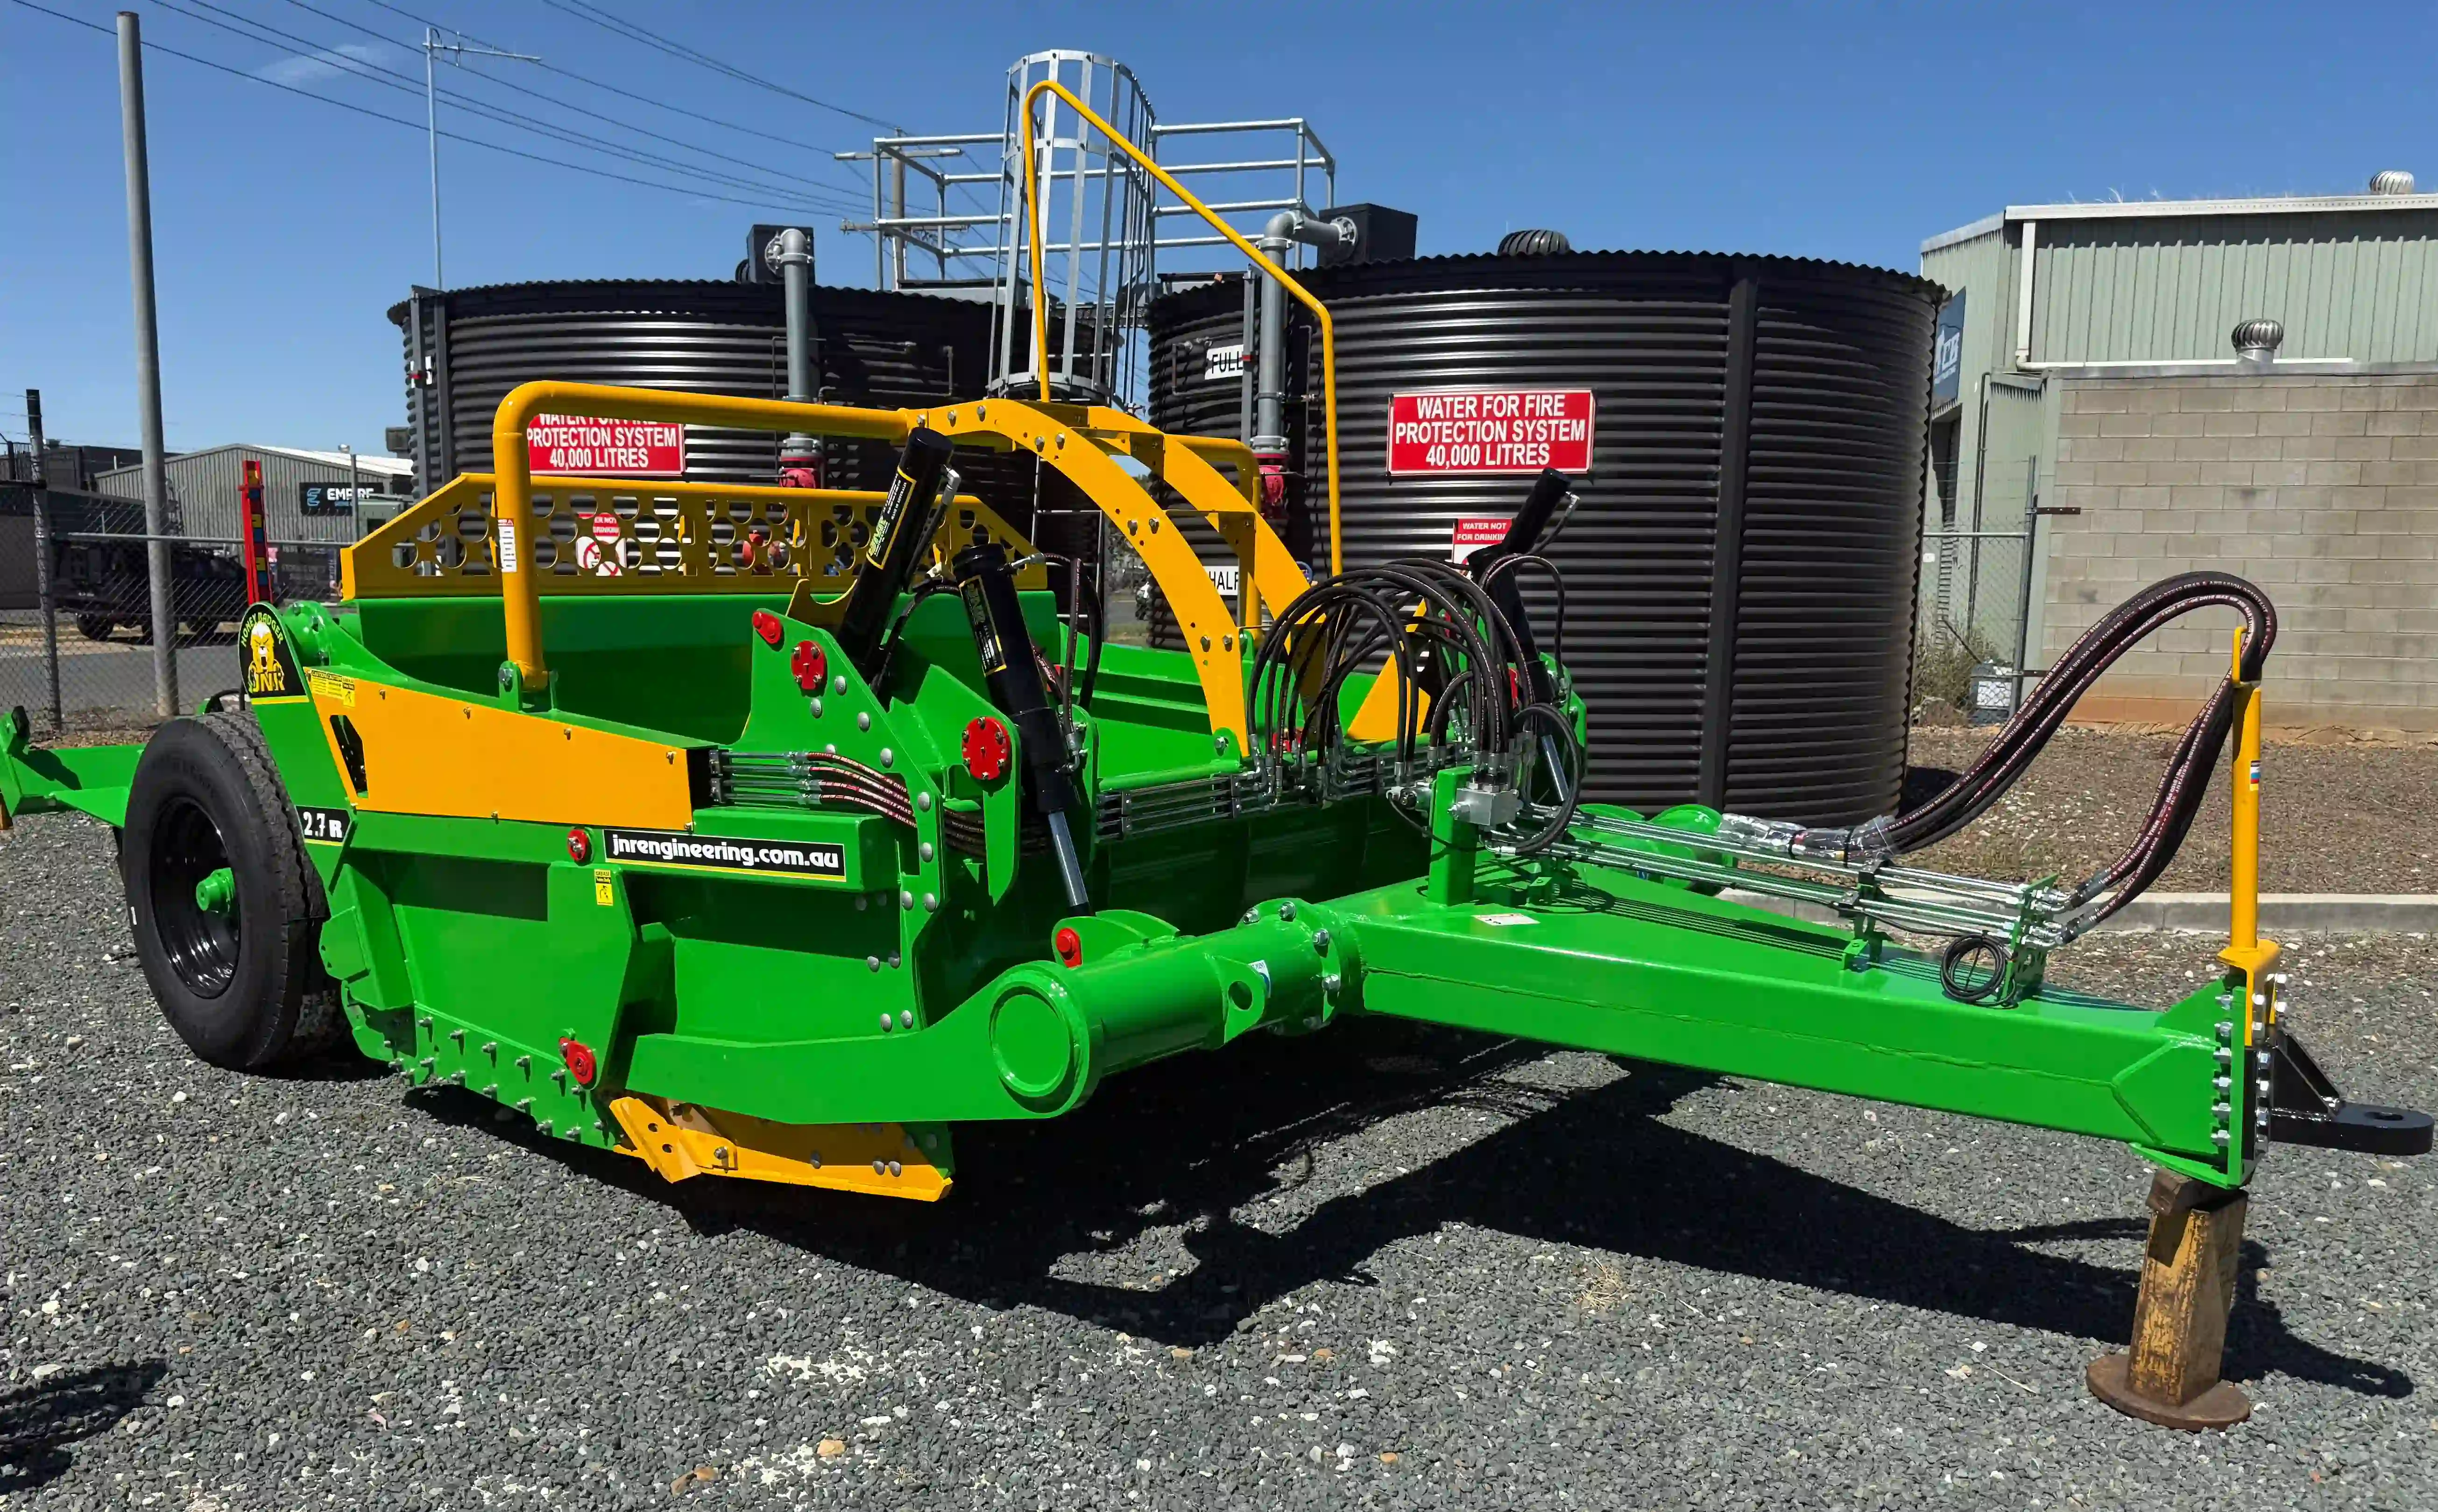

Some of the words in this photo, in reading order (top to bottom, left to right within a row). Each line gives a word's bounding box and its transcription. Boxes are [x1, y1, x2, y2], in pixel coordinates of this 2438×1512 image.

[1212, 351, 1243, 374] FULL
[1416, 395, 1478, 419] WATER
[1483, 394, 1519, 418] FOR
[1525, 394, 1566, 417] FIRE
[527, 427, 611, 447] PROTECTION
[615, 427, 677, 447] SYSTEM
[1395, 420, 1508, 444] PROTECTION
[1512, 419, 1586, 443] SYSTEM
[549, 448, 592, 471] 40,000
[595, 448, 649, 468] LITRES
[1425, 444, 1480, 469] 40,000
[1485, 443, 1551, 466] LITRES
[327, 488, 374, 501] EMPRE
[240, 613, 257, 648] HONEY
[257, 612, 284, 645] BADGER
[303, 811, 326, 837] 2.7
[328, 819, 343, 838] R
[612, 834, 840, 869] jnrengineering.com.au
